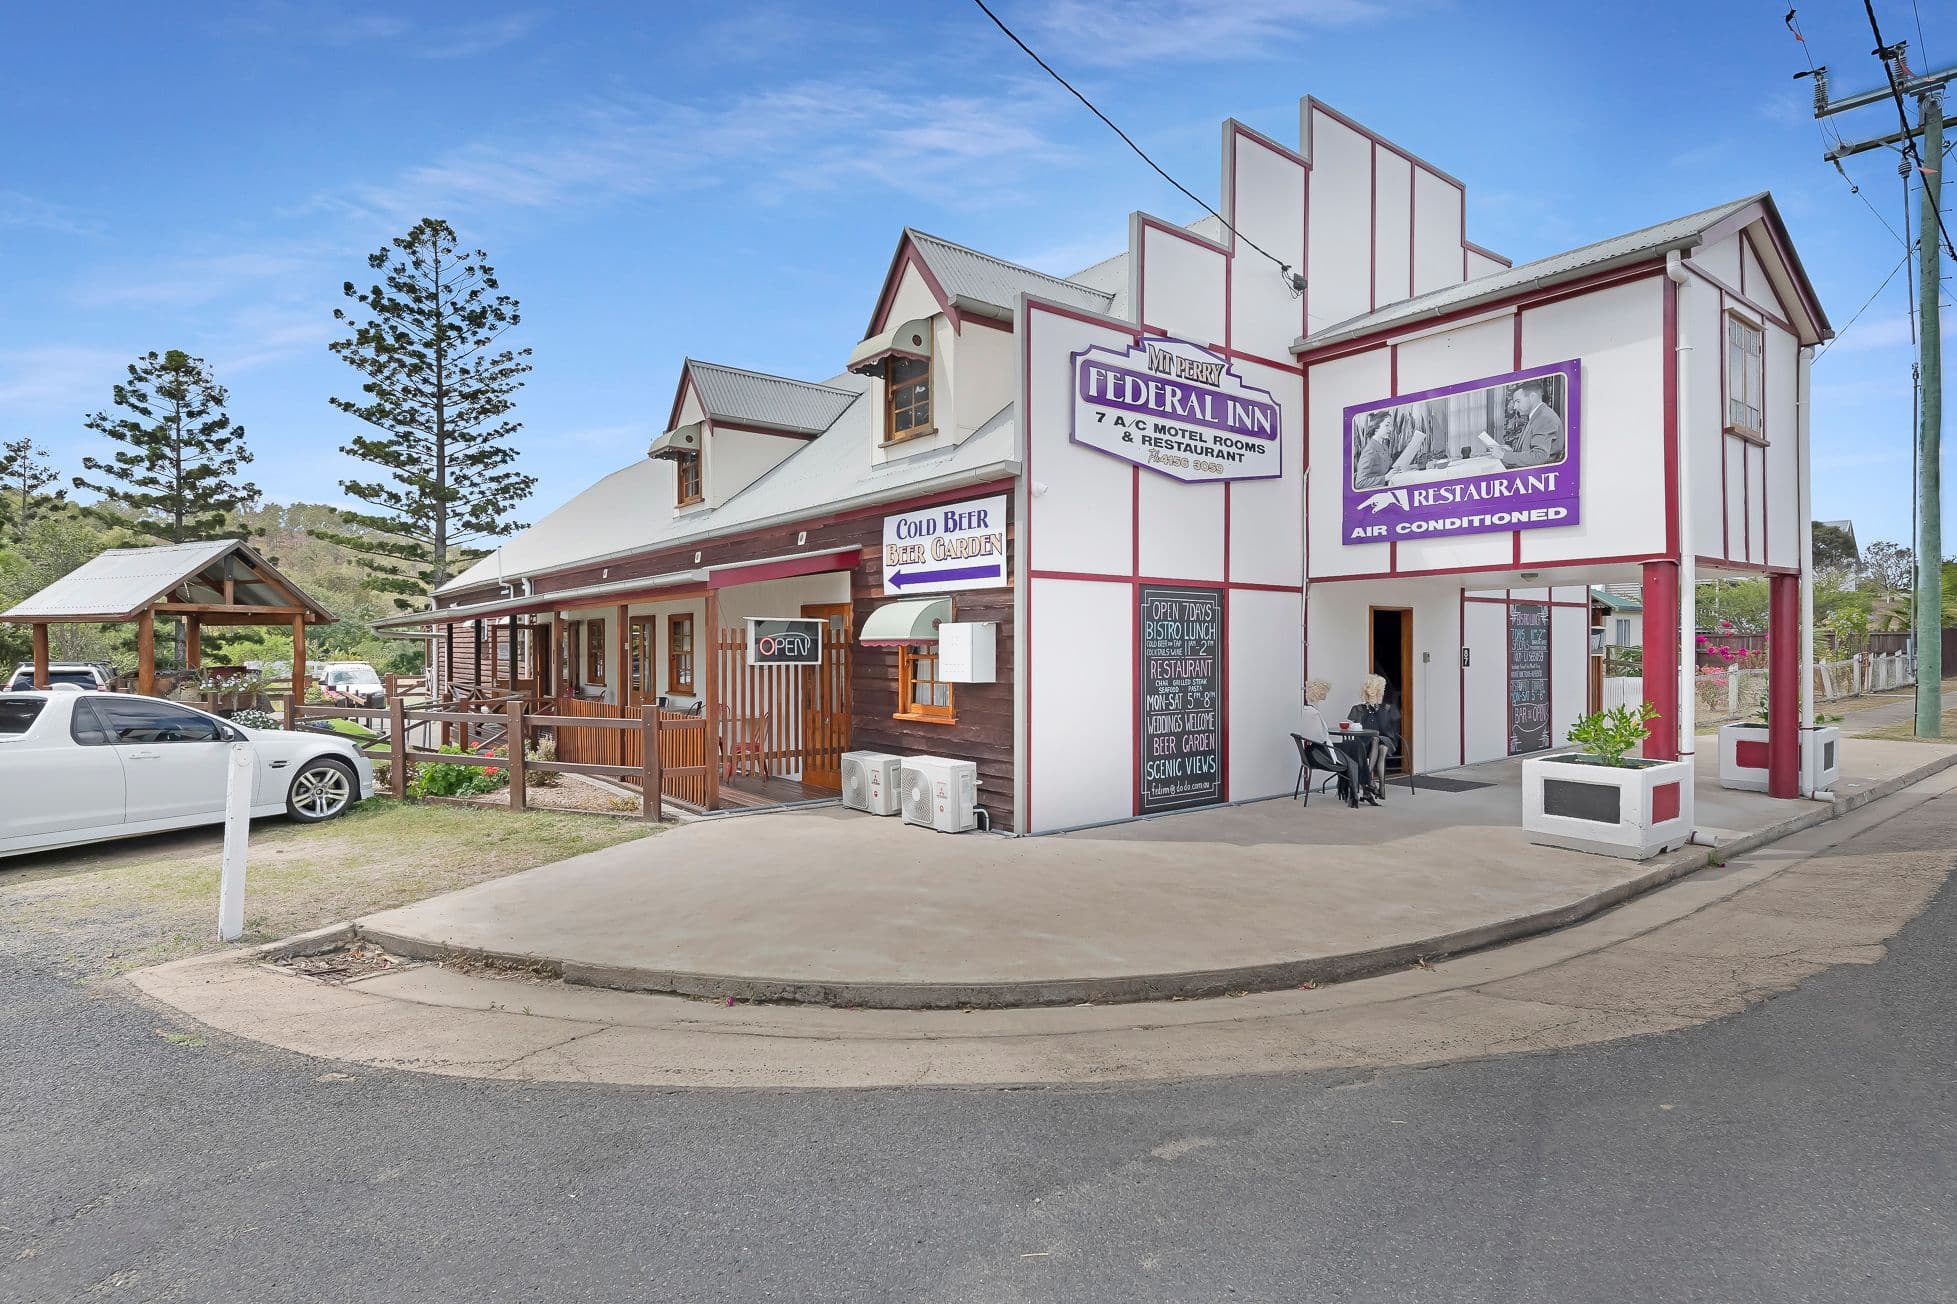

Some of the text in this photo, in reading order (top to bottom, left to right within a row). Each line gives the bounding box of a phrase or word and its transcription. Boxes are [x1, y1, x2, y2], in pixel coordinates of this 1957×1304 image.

[1176, 356, 1224, 388] PERRY
[1088, 366, 1271, 435] FEDERAL INN
[1095, 411, 1266, 455] 7 A/C MOTEL ROOMS
[1121, 431, 1245, 463] & RESTAURANT
[1192, 459, 1224, 474] 3059
[1413, 472, 1559, 507] RESTAURANT
[896, 509, 989, 540] COLD BEER
[1350, 507, 1568, 539] AIR CONDITIONED
[885, 532, 1003, 567] BEER GARDEN
[1153, 601, 1179, 621] OPEN
[1146, 621, 1216, 640] BISTRO LUNCH
[760, 637, 808, 656] OPEN
[1150, 659, 1213, 679] RESTAURANT
[1146, 693, 1184, 711] MON-SAT
[1147, 712, 1215, 735] WEDDINGS WELCOME
[1153, 733, 1215, 756] BEER GARDEN
[1147, 755, 1216, 780] SCENIC VIEWS
